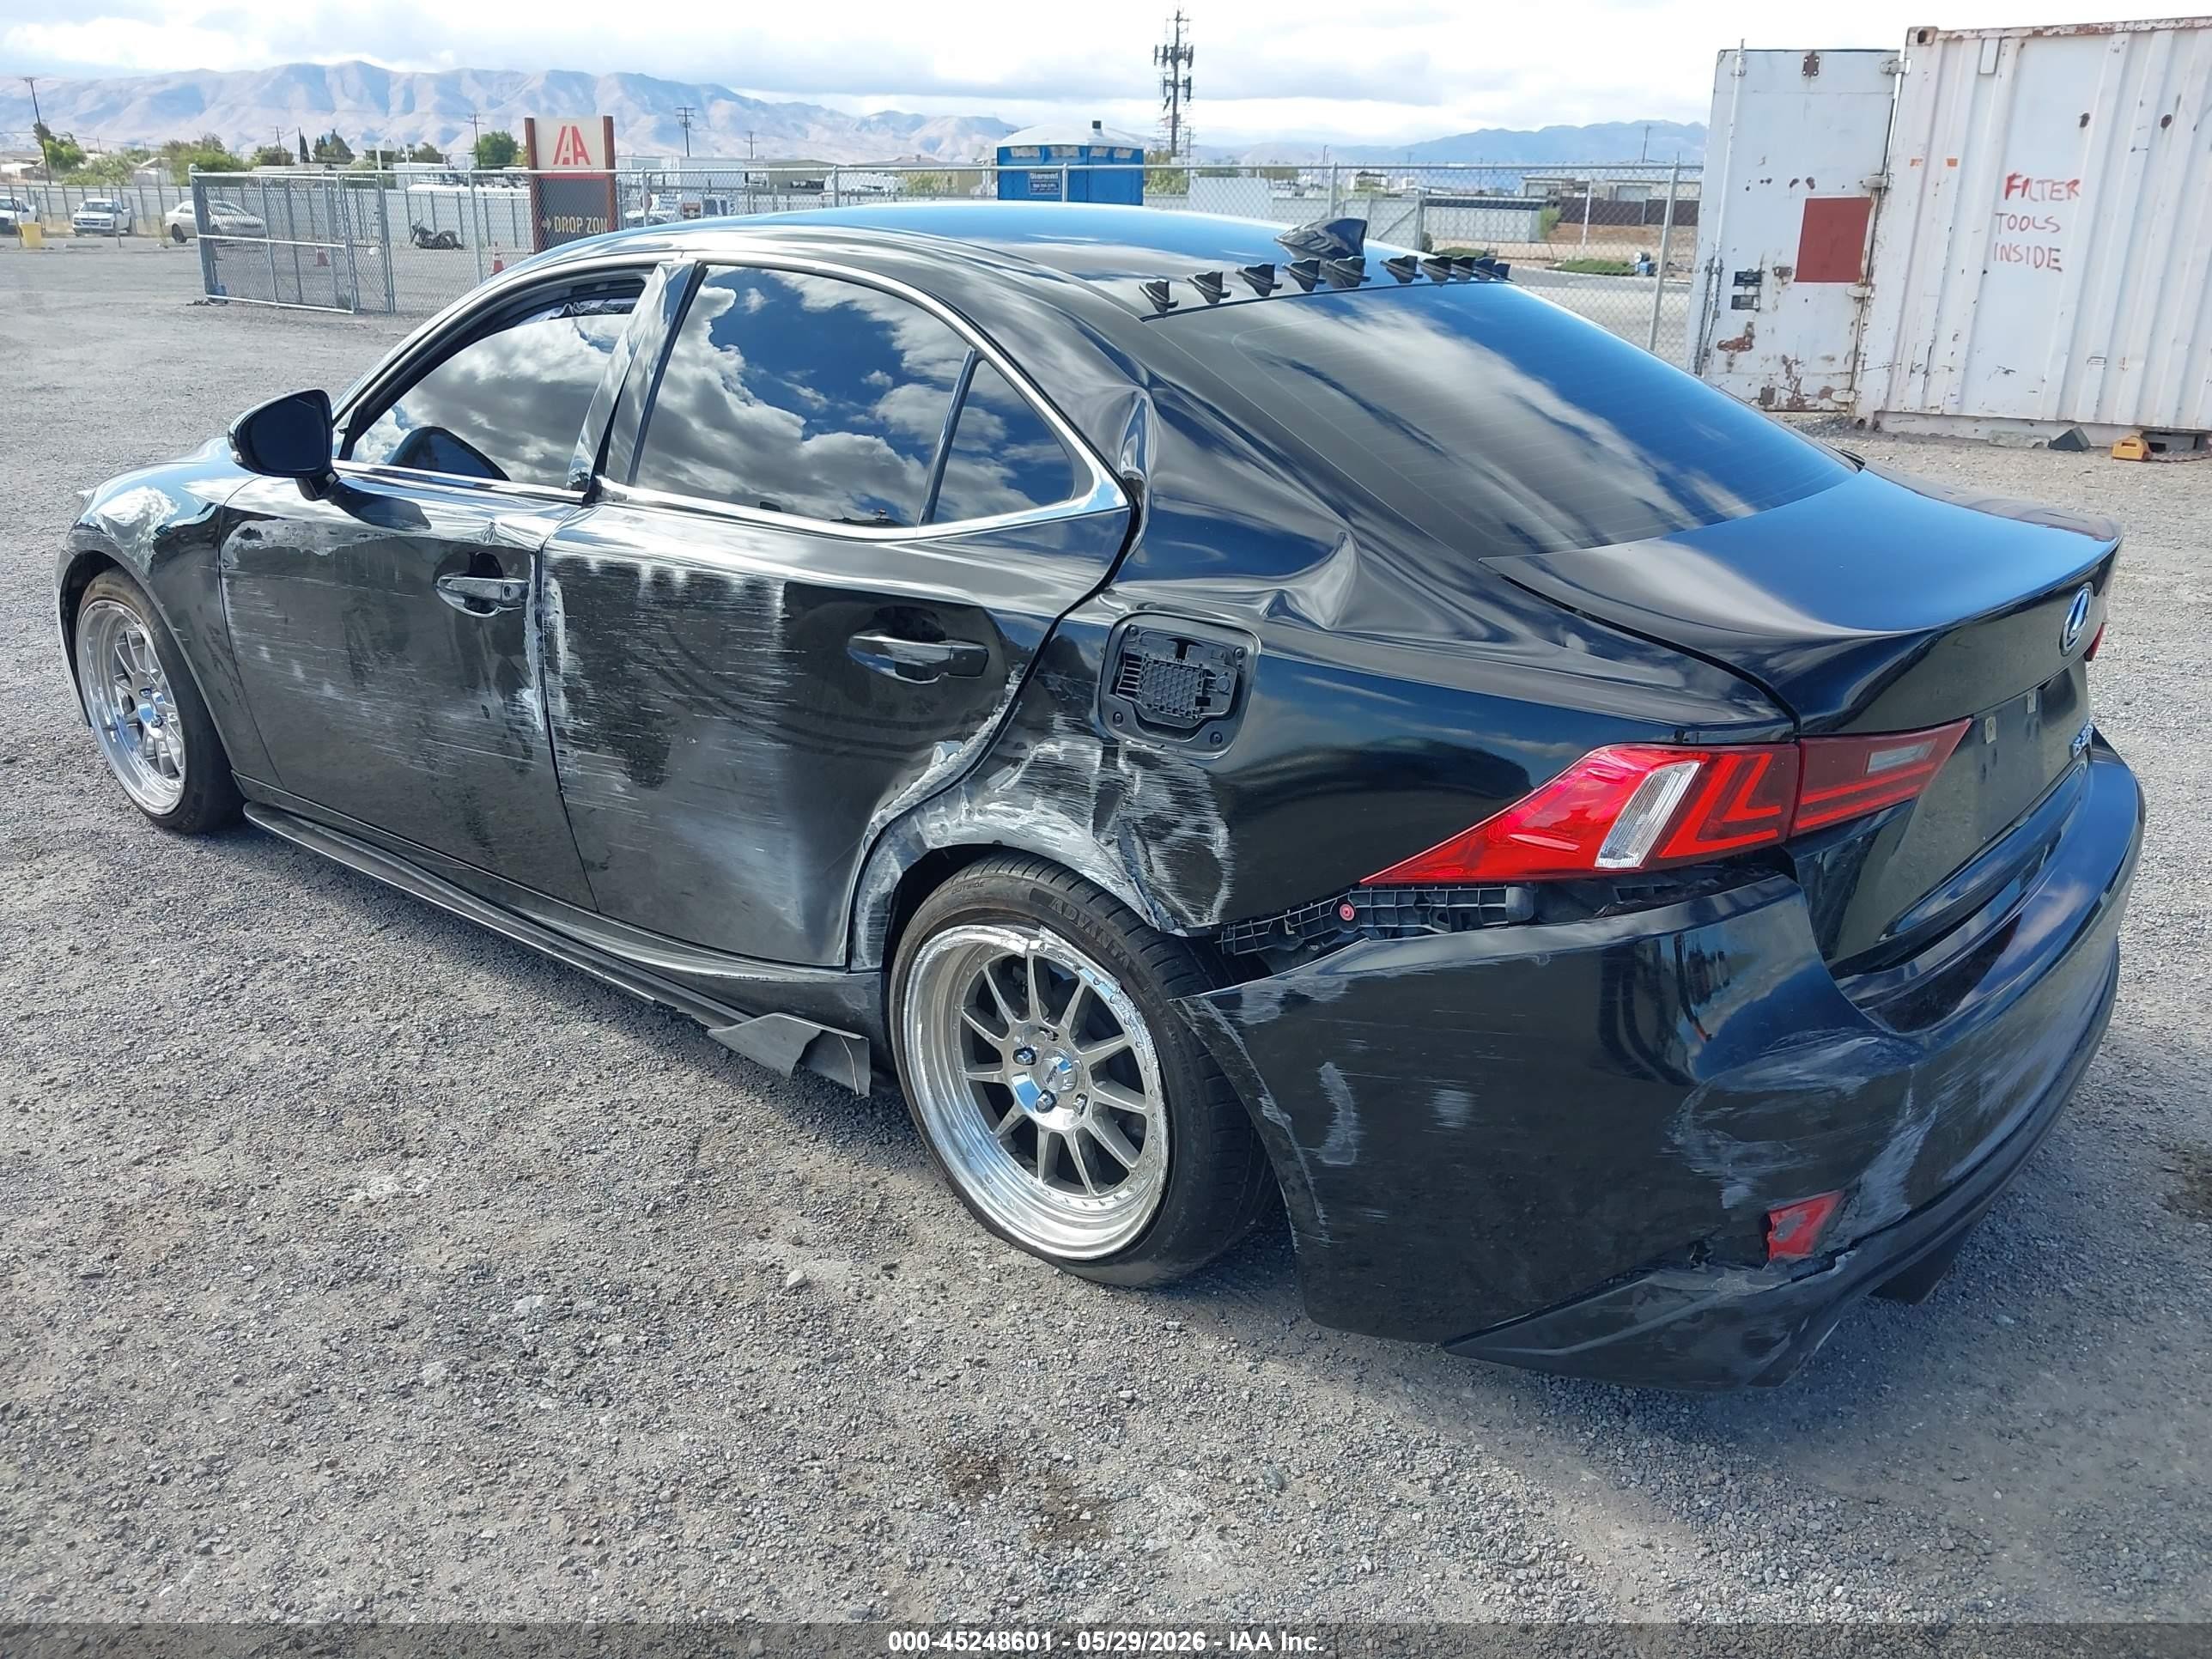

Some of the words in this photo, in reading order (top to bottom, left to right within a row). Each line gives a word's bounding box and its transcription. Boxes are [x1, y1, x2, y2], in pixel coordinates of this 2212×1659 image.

[2003, 171, 2081, 203] FILTER
[554, 216, 584, 234] DROP
[586, 216, 608, 234] ZON
[1994, 211, 2062, 234] TOOLS
[1993, 240, 2063, 272] INSIDE
[1047, 896, 1133, 971] ADVANTA
